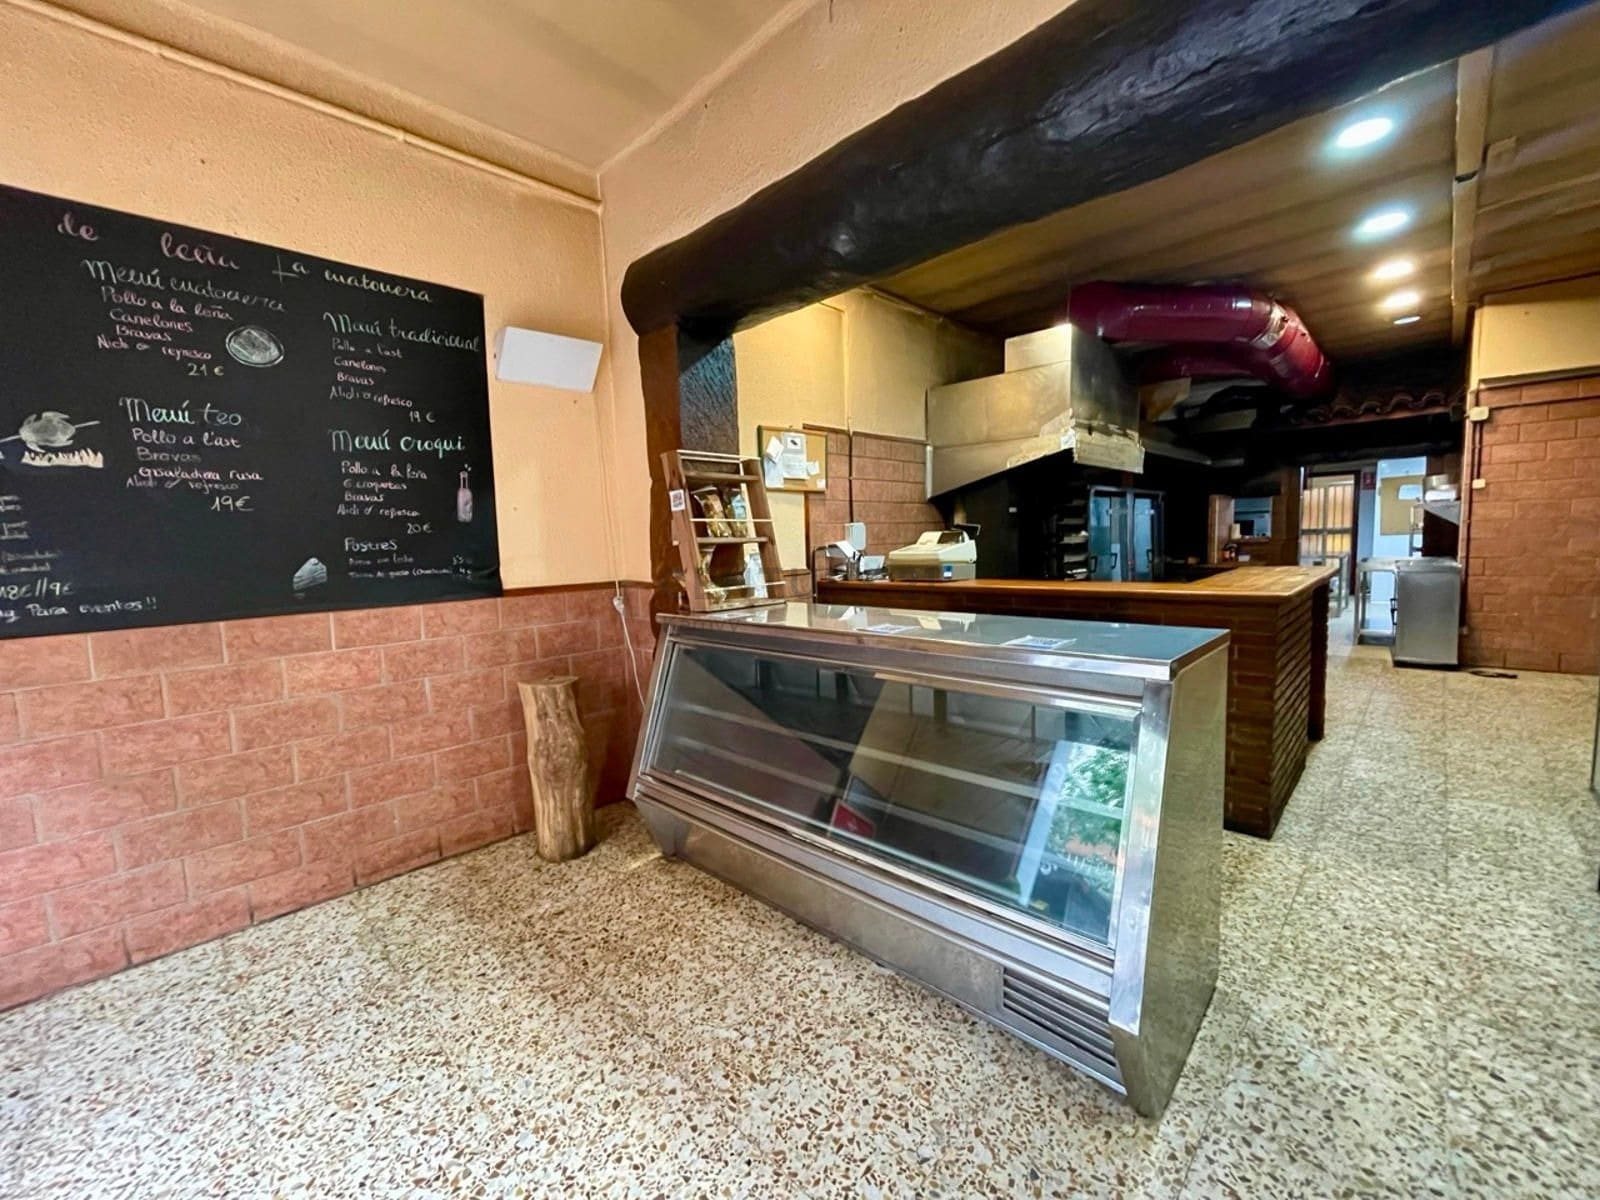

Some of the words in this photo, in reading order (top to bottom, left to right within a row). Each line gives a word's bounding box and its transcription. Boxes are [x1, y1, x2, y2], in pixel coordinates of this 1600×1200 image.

[57, 211, 98, 241] de
[81, 259, 165, 290] Menú
[271, 255, 310, 288] La
[101, 285, 147, 307] Pollo
[151, 300, 163, 311] a
[170, 298, 187, 314] la
[110, 308, 194, 333] Canelones
[116, 324, 172, 342] Bravas
[332, 337, 355, 351] Pollo
[187, 362, 208, 377] 21
[213, 366, 225, 377] €
[336, 370, 375, 386] Bravas
[119, 397, 195, 425] Menú
[197, 402, 243, 426] teo
[409, 410, 421, 423] 19
[132, 427, 177, 444] Pollo
[183, 435, 195, 444] a
[330, 429, 391, 453] Menú
[136, 446, 202, 461] Bravas
[229, 470, 264, 480] rusa
[341, 460, 369, 474] Pollo
[344, 490, 384, 502] Bravas
[344, 537, 397, 552] Postres
